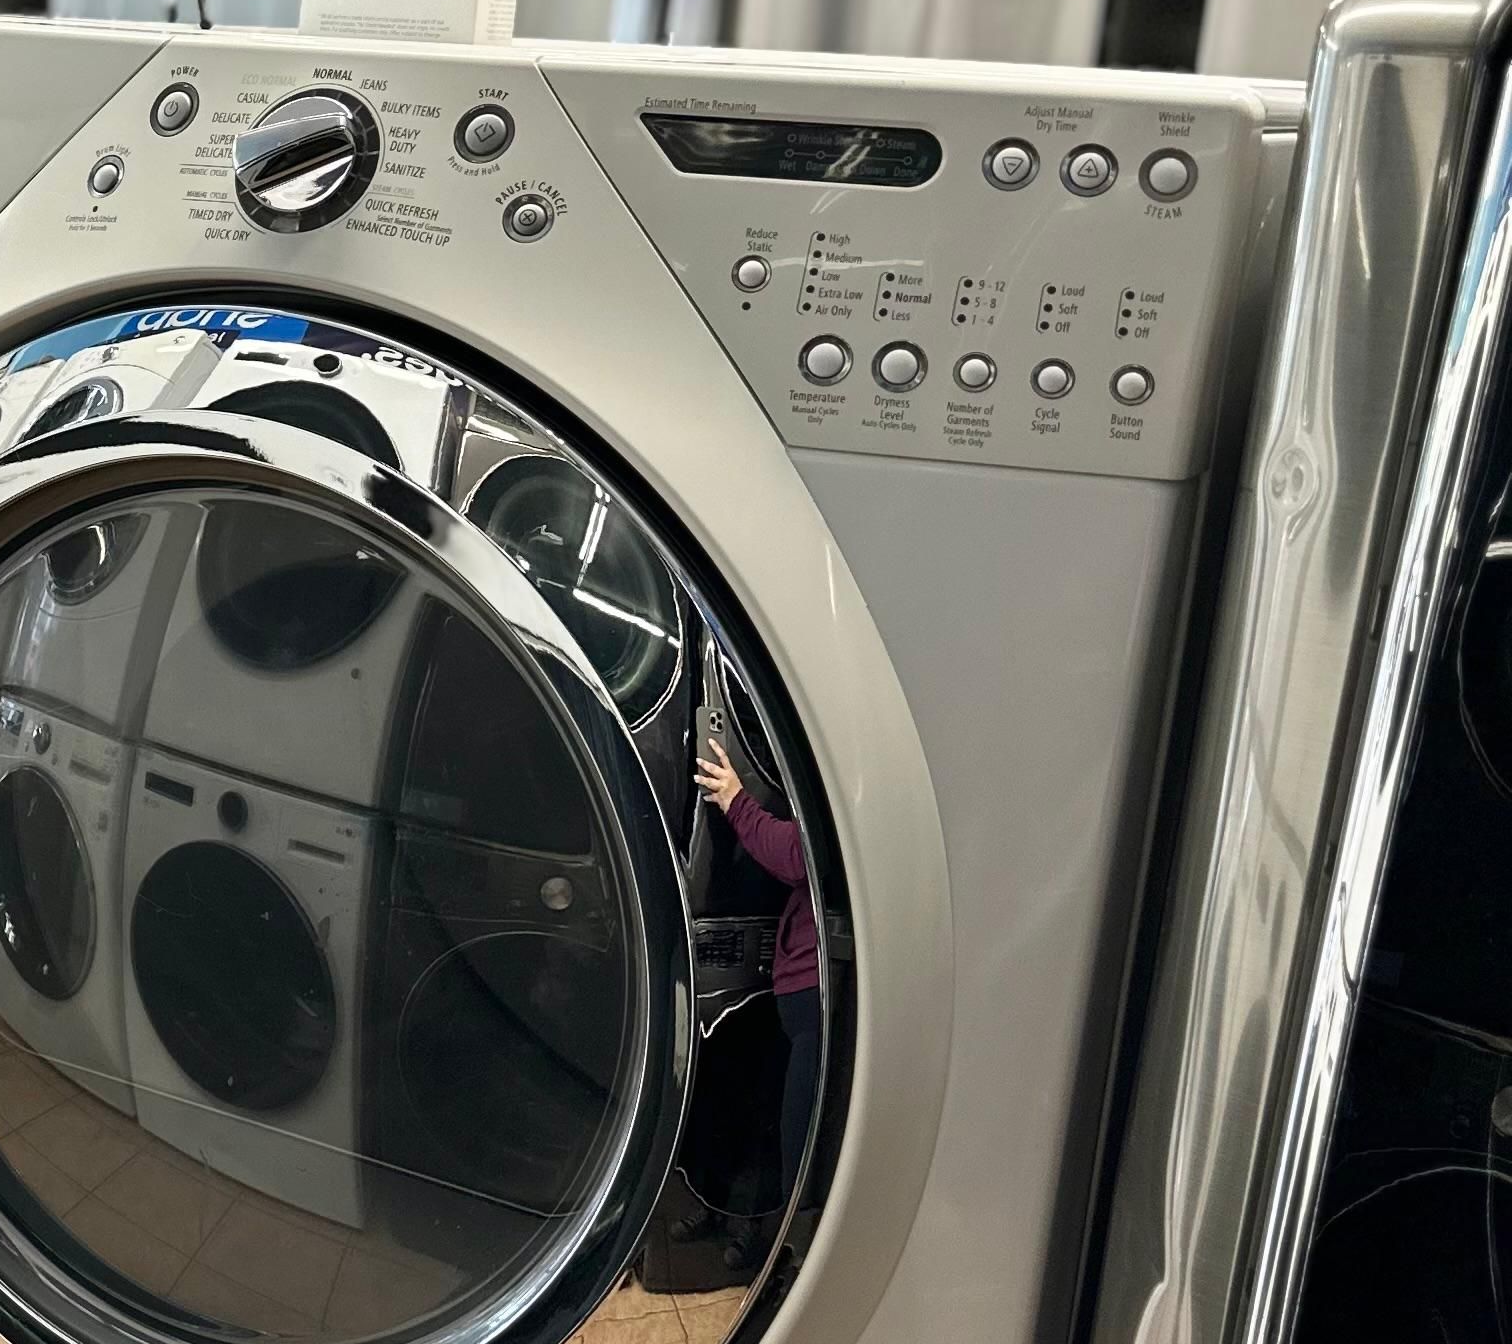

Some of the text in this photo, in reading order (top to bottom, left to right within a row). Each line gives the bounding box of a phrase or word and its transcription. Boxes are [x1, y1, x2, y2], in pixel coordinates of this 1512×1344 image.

[170, 65, 200, 78] POWER
[312, 67, 353, 82] NORMAL
[359, 78, 389, 91] JEANS
[236, 92, 270, 105] CASUAL
[478, 88, 510, 102] START
[380, 101, 442, 119] BULKY ITEMS
[644, 96, 757, 114] Estimated Time Remaining
[211, 112, 251, 125] DELICATE
[1024, 105, 1095, 120] Adjust Manual
[1158, 111, 1196, 125] Wrinkle
[1036, 119, 1078, 134] Dry Time
[1159, 124, 1191, 138] Shield
[208, 134, 236, 145] SUPER
[387, 127, 421, 141] HEAVY
[194, 146, 234, 159] DELICATE
[389, 140, 417, 154] DUTY
[384, 162, 427, 179] SANITIZE
[447, 155, 501, 178] Press and Hold
[495, 179, 569, 218] PAUSE CANCEL
[188, 208, 234, 223] TIMED DRY
[365, 198, 440, 222] QUICK REFRESH
[1144, 204, 1183, 220] STEAM
[204, 227, 251, 242] QUICK DRY
[345, 218, 451, 247] ENHANCED TOUCH UP
[745, 227, 779, 241] Reduce
[829, 233, 851, 245] High
[747, 240, 774, 253] Static
[825, 252, 863, 265] Medium
[821, 270, 841, 282] Low
[898, 274, 923, 286] More
[995, 280, 1006, 293] 12
[1061, 284, 1086, 297] Loud
[818, 287, 864, 301] Extra Low
[894, 292, 932, 305] Normal
[1140, 292, 1165, 304] Loud
[814, 304, 853, 319] Air Only
[891, 310, 911, 321] Less
[1058, 303, 1079, 316] Soft
[1137, 309, 1158, 321] Soft
[1054, 322, 1071, 333] Off
[1133, 327, 1150, 339] Off
[789, 389, 846, 406] Temperature
[873, 394, 910, 409] Dryness
[791, 405, 840, 417] Manual Cycles
[879, 410, 904, 421] Level
[946, 401, 995, 416] Number of
[1034, 407, 1061, 421] Cycle
[807, 415, 824, 425] Only
[861, 419, 917, 433] Auto Cycles Only
[946, 414, 991, 428] Garments
[1110, 413, 1144, 428] Button
[942, 426, 965, 436] Steam
[1031, 421, 1061, 435] Signal
[1109, 427, 1141, 441] Sound
[947, 436, 985, 448] Cycle Only
